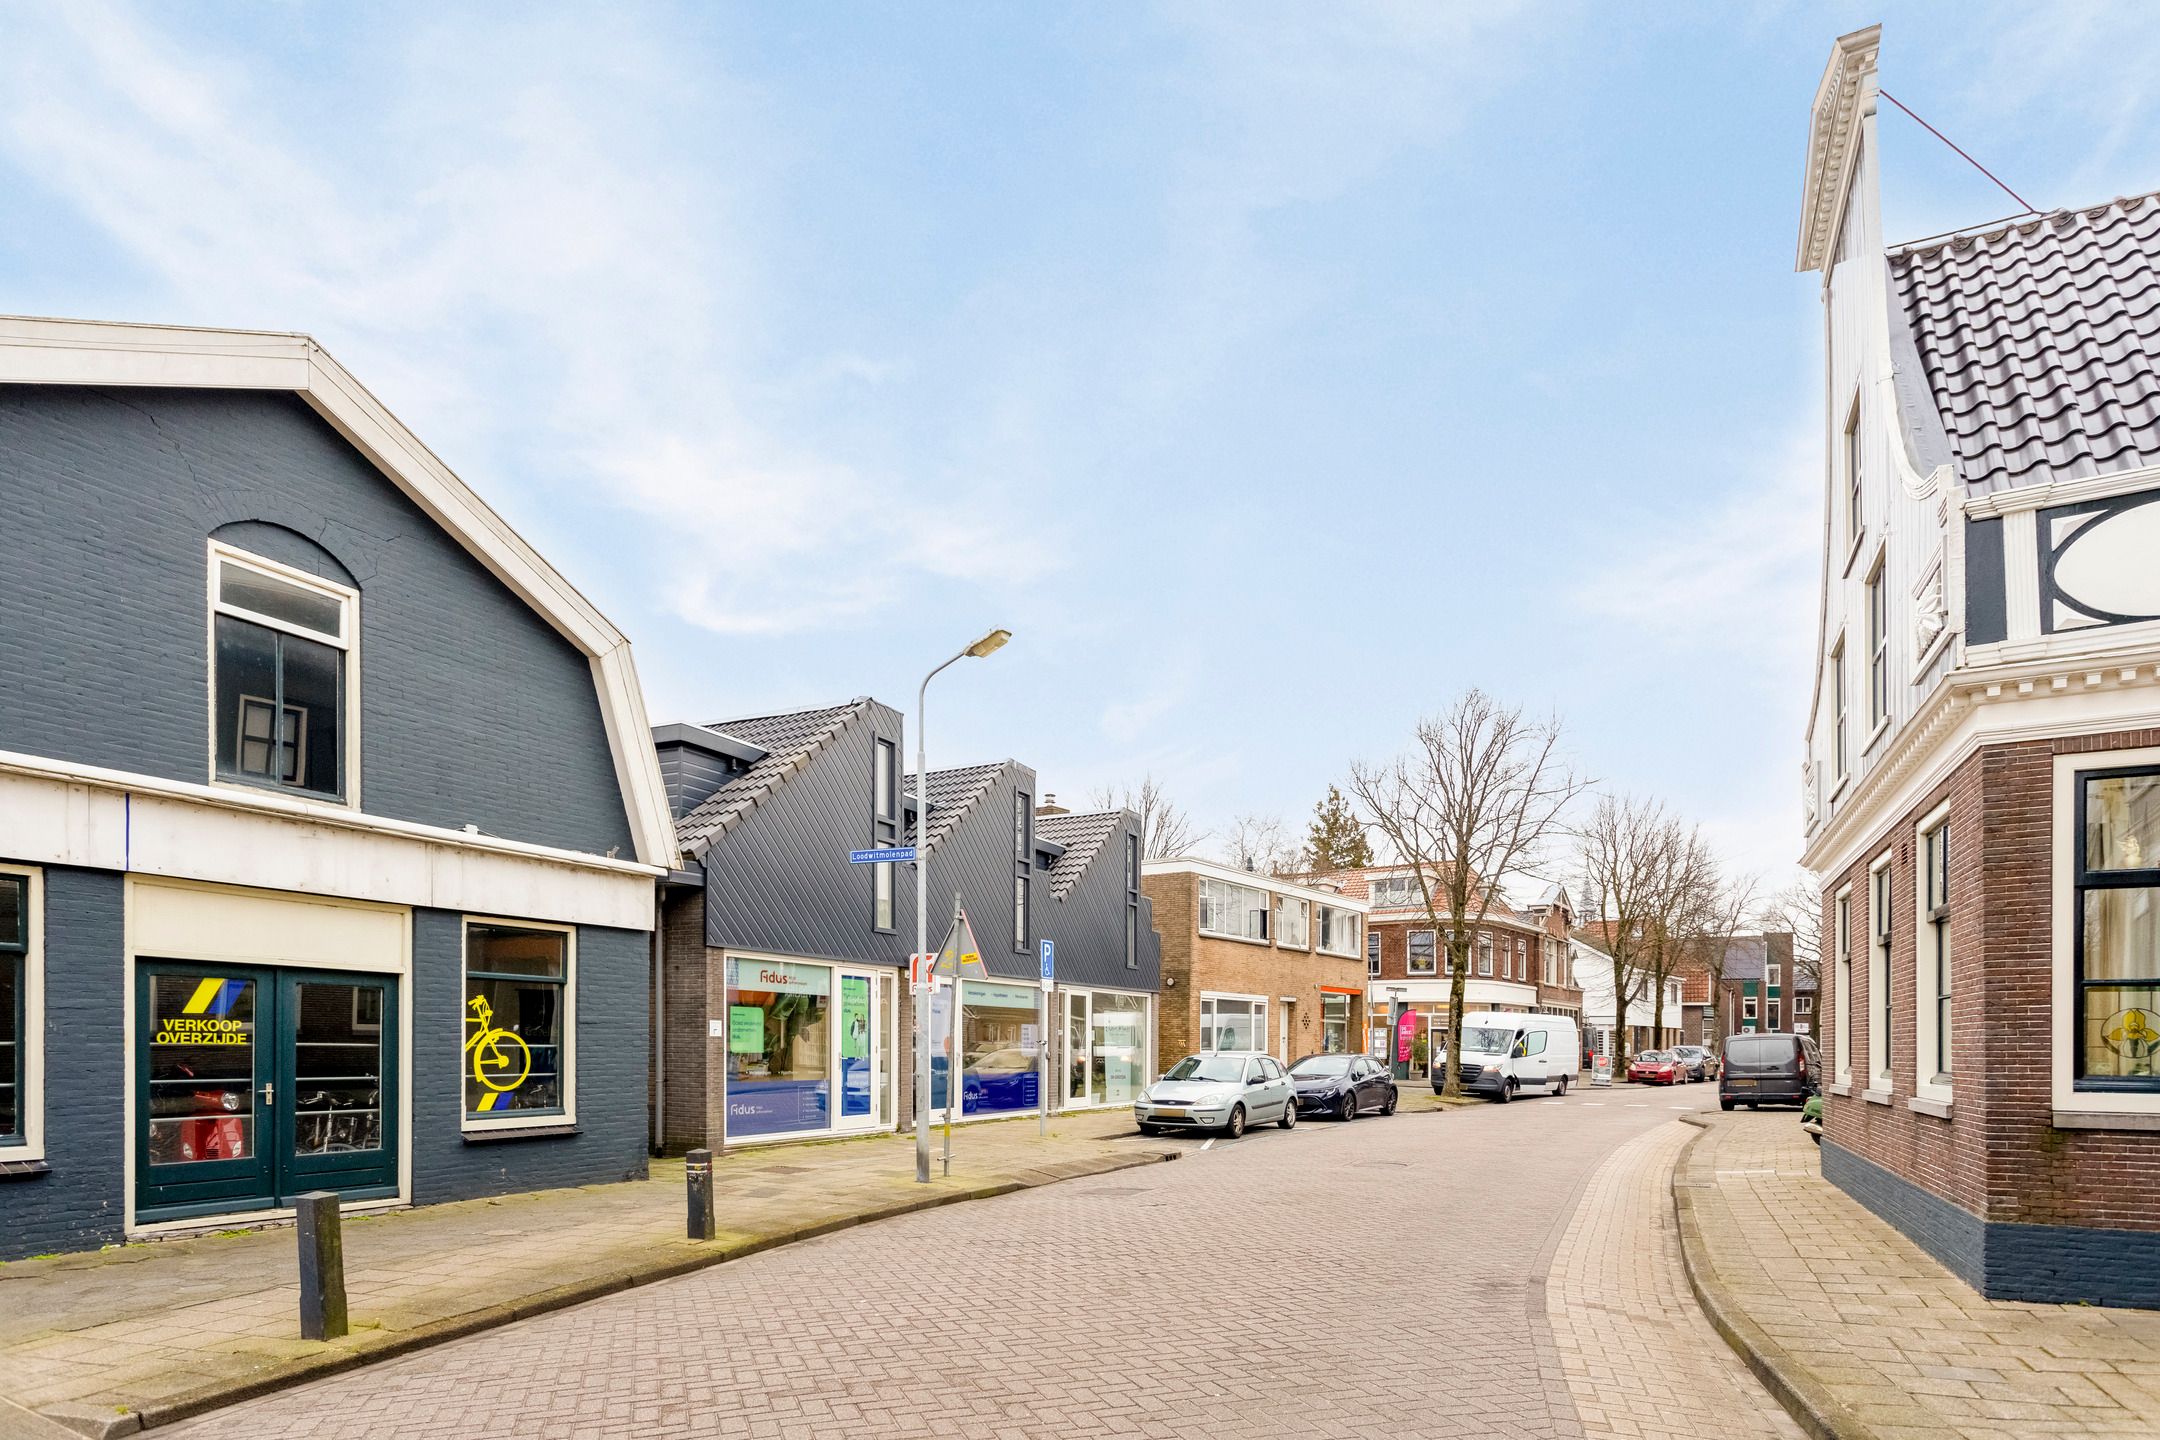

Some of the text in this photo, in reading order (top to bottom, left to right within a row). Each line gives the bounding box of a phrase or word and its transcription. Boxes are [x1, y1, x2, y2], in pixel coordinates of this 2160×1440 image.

[852, 850, 913, 860] Loodwitmolenpad
[1044, 943, 1051, 962] P
[760, 969, 788, 984] Fidus
[163, 1019, 242, 1032] VERKOOP
[156, 1031, 248, 1045] OVERZIJDE
